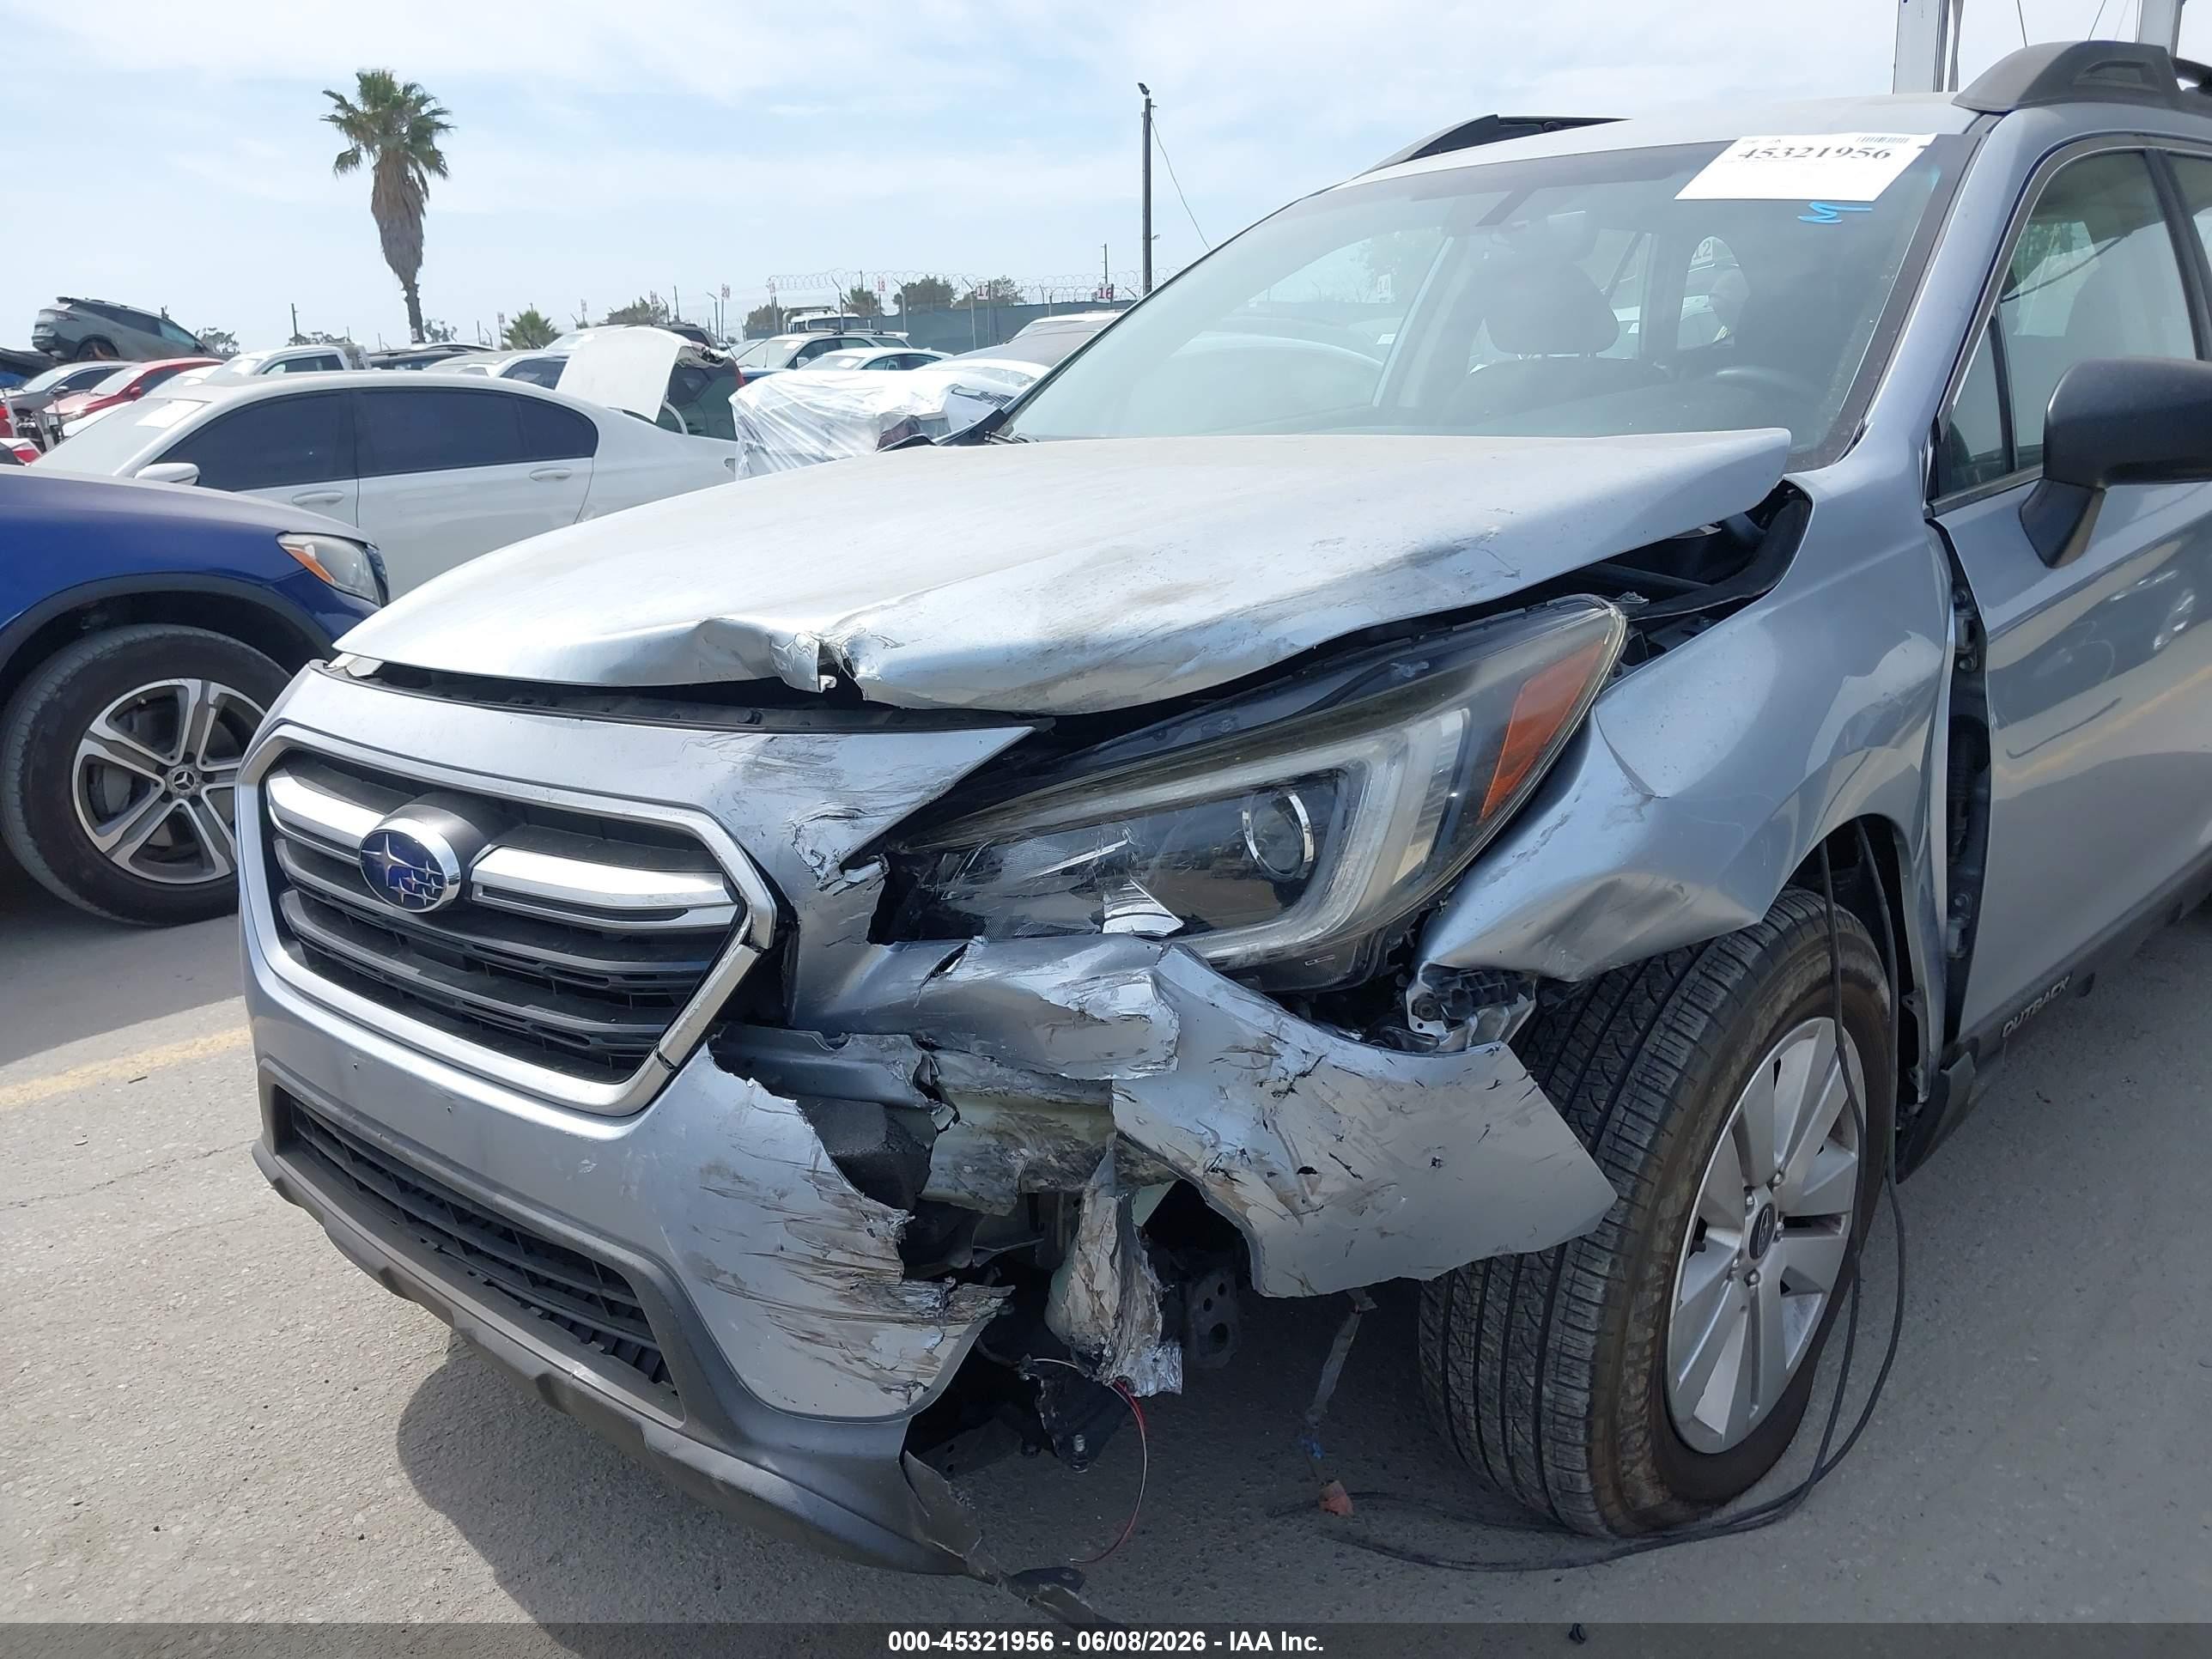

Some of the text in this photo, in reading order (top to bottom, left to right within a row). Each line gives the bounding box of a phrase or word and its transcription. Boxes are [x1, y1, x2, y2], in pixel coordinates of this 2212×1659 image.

[1737, 146, 1895, 160] 45321956
[977, 284, 989, 297] 17
[1097, 287, 1114, 300] 16
